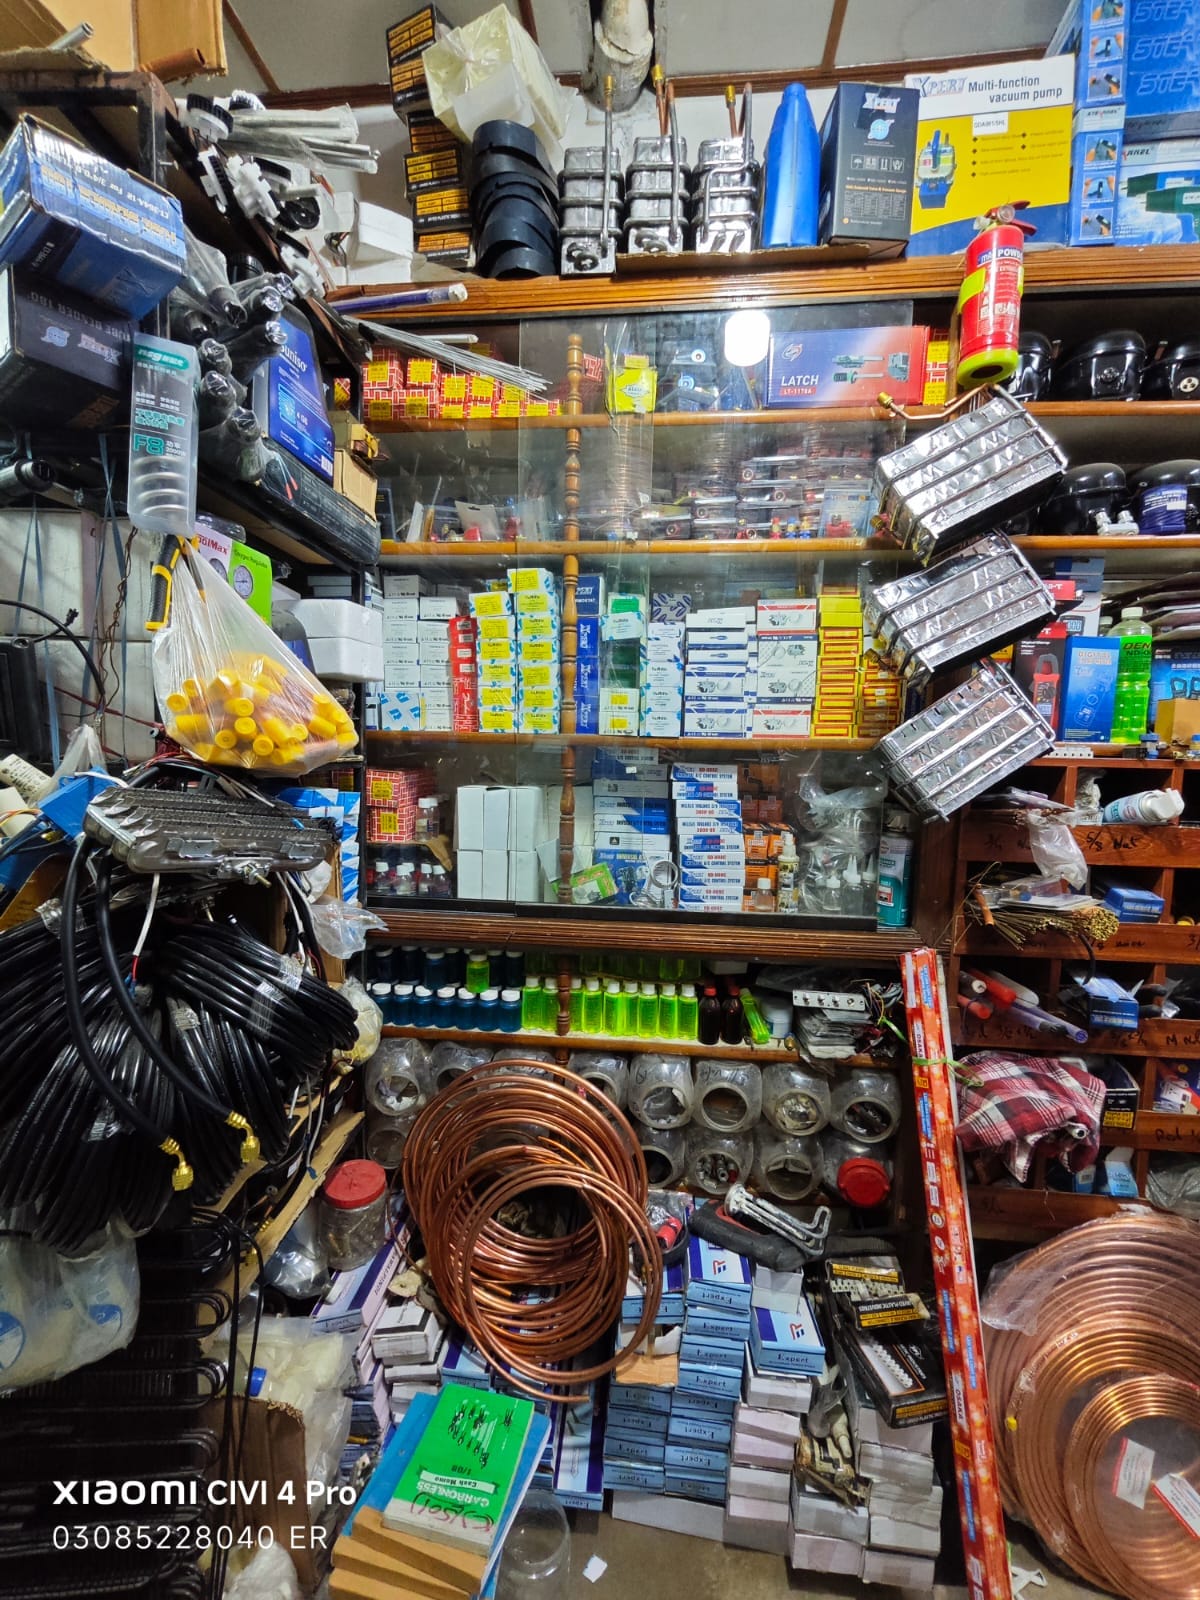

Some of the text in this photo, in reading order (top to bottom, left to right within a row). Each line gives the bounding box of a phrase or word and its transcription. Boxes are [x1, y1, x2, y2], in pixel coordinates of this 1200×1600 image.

[968, 76, 1040, 93] Multi-function
[989, 87, 1063, 103] vacuum pump
[781, 374, 819, 386] LATCH
[133, 432, 165, 455] F8
[1123, 642, 1151, 650] DEN
[954, 1388, 964, 1420] OSAKA
[434, 1476, 477, 1489] Cash Memo
[415, 1480, 490, 1508] CARBONLESS
